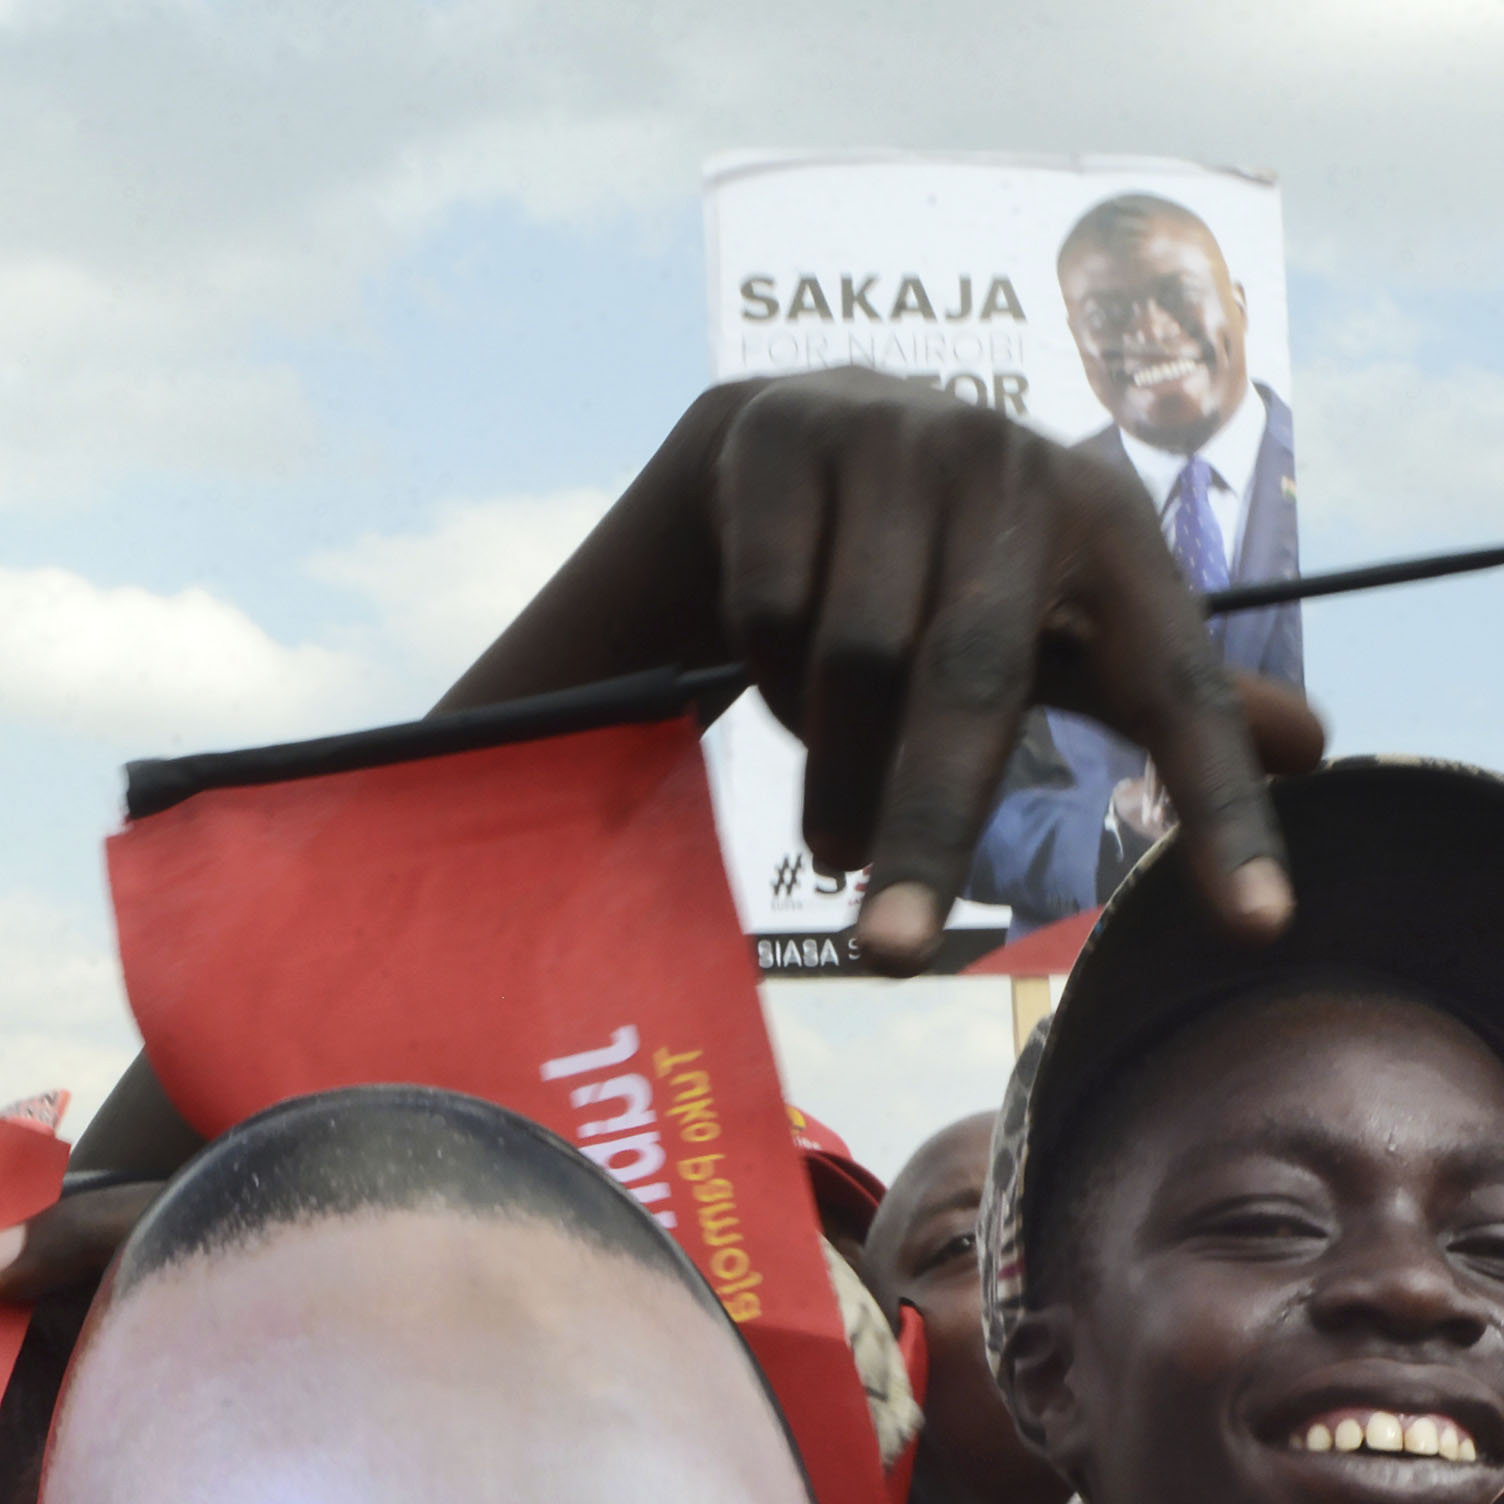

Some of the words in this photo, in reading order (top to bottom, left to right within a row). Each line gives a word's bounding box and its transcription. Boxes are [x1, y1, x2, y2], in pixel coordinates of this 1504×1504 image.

[739, 271, 1028, 323] SAKAJA
[742, 331, 829, 367] FOR
[849, 331, 1025, 367] NAIROBI
[757, 938, 840, 968] SIASA
